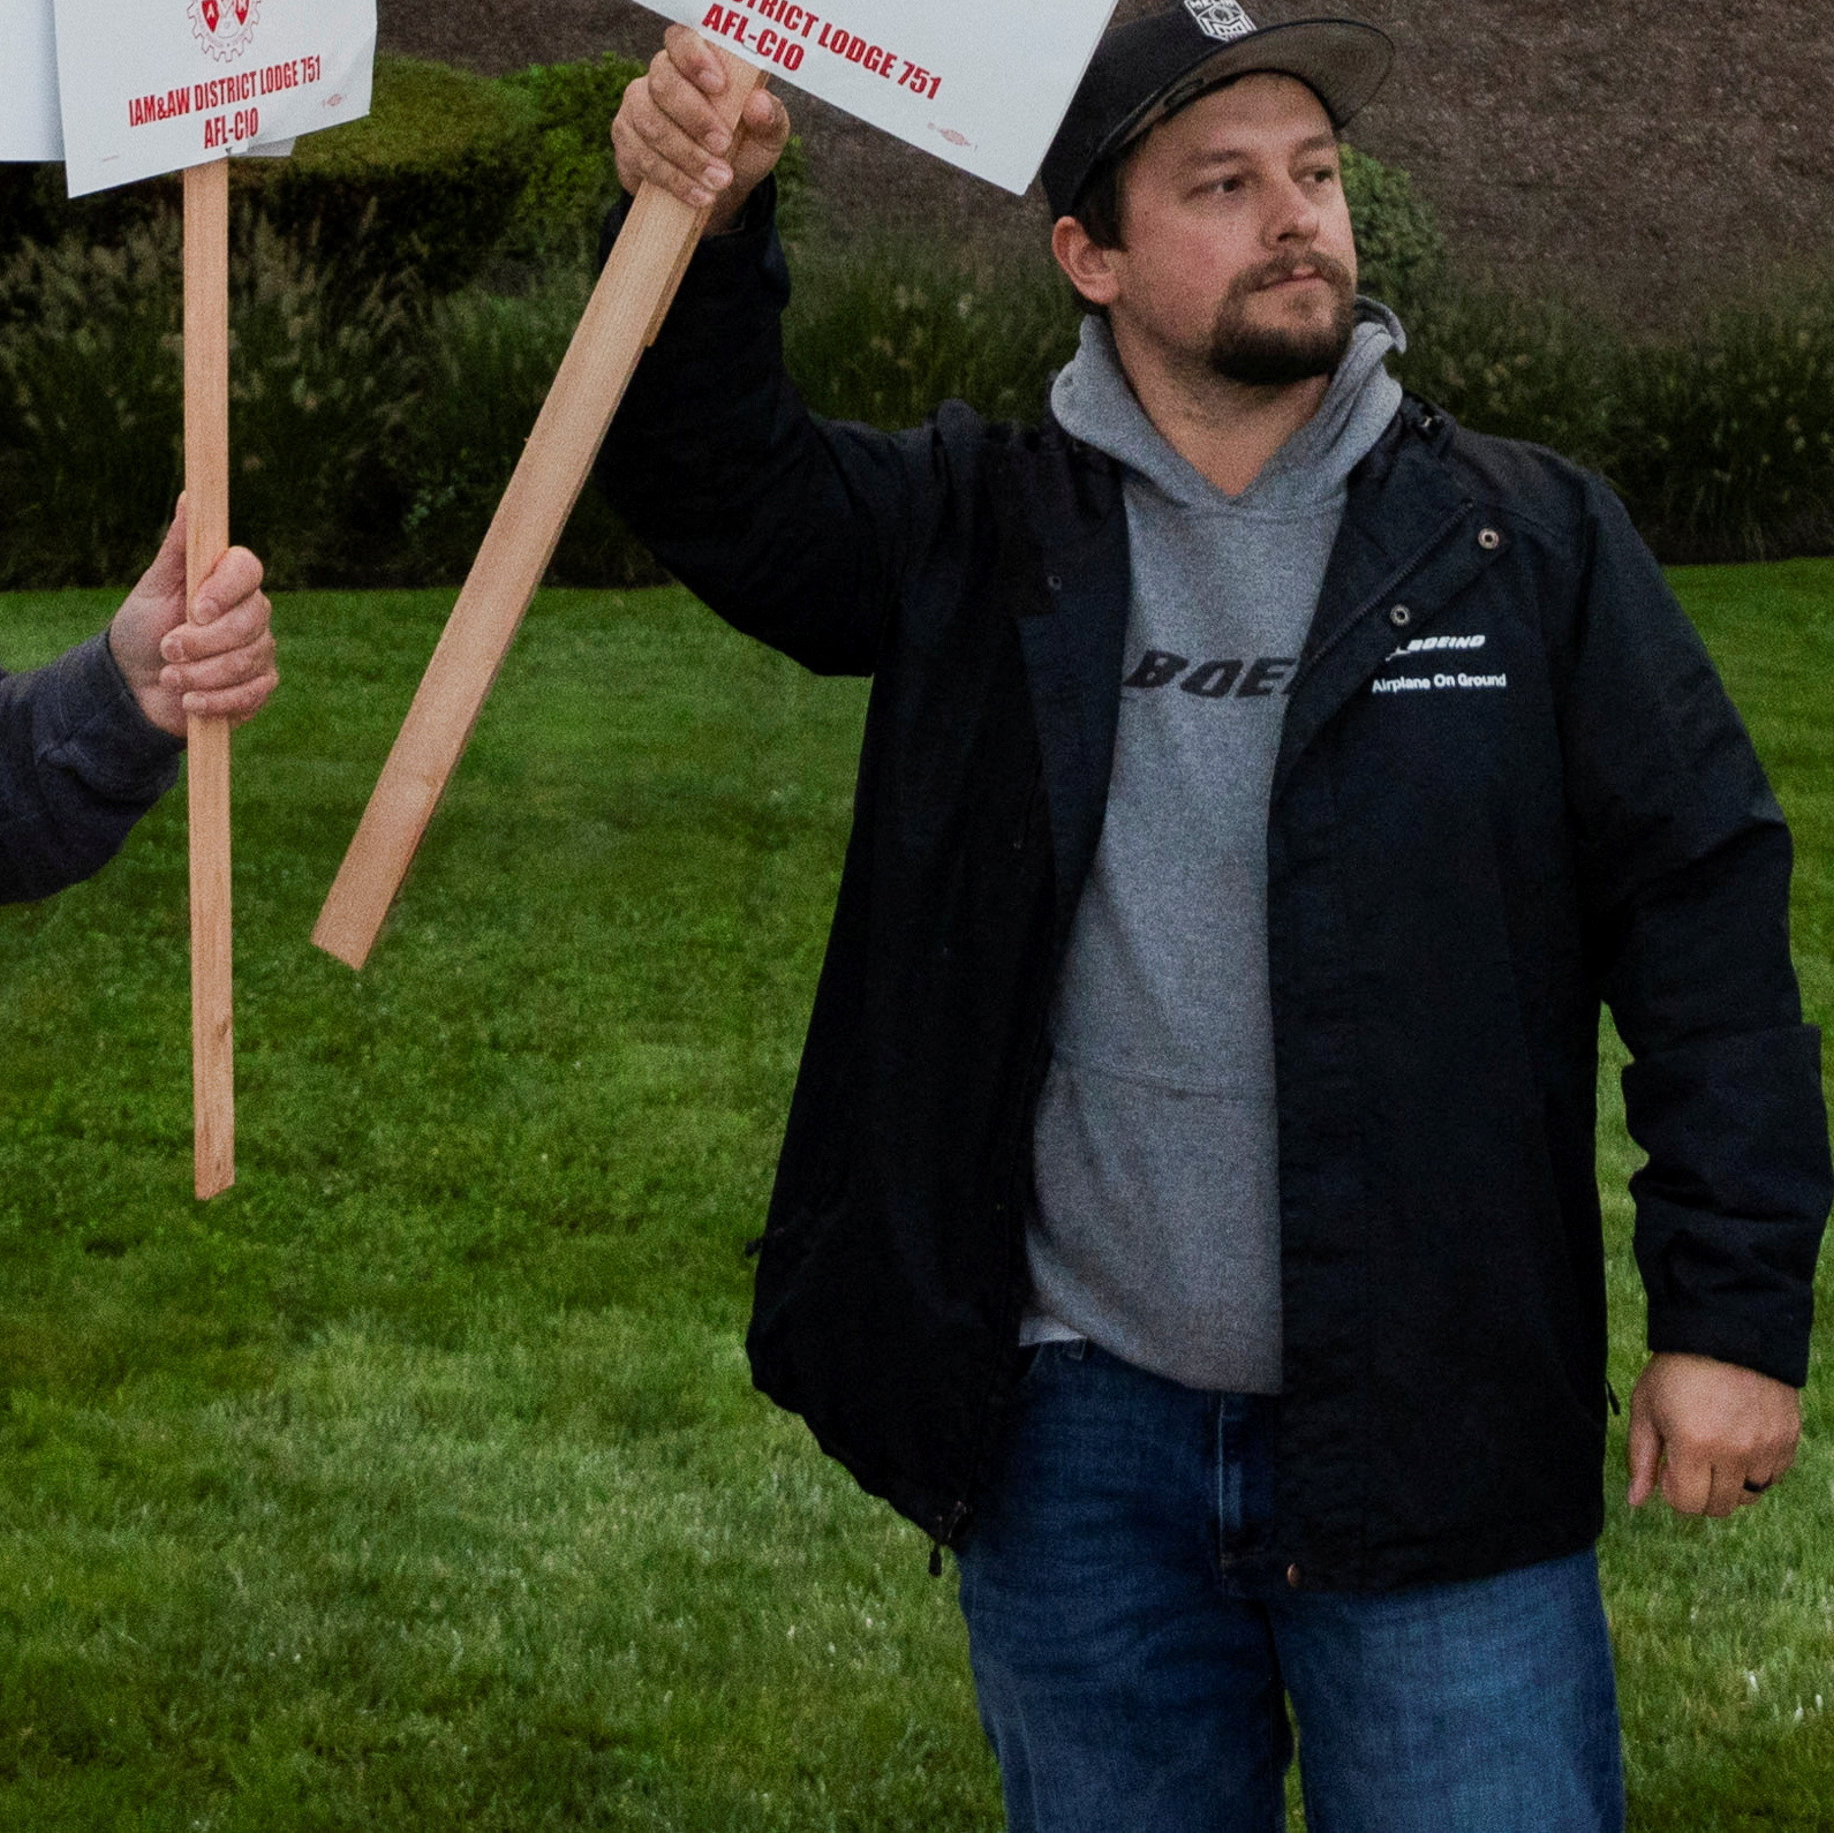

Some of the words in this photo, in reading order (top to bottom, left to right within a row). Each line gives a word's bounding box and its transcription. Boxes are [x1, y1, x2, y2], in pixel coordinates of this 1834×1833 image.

[702, 4, 804, 71] AFL-CIO
[818, 23, 897, 77] LODGE
[898, 62, 941, 98] 751
[129, 88, 190, 126] IAM&AW
[194, 72, 256, 111] DISTRICT
[260, 61, 299, 94] LODGE
[300, 55, 321, 84] 751
[204, 108, 258, 148] AFL-CIO
[1407, 635, 1485, 651] BOEING
[1122, 649, 1299, 698] BOE
[1373, 677, 1431, 693] Airplane
[1434, 674, 1455, 687] On
[1458, 673, 1506, 687] Ground
